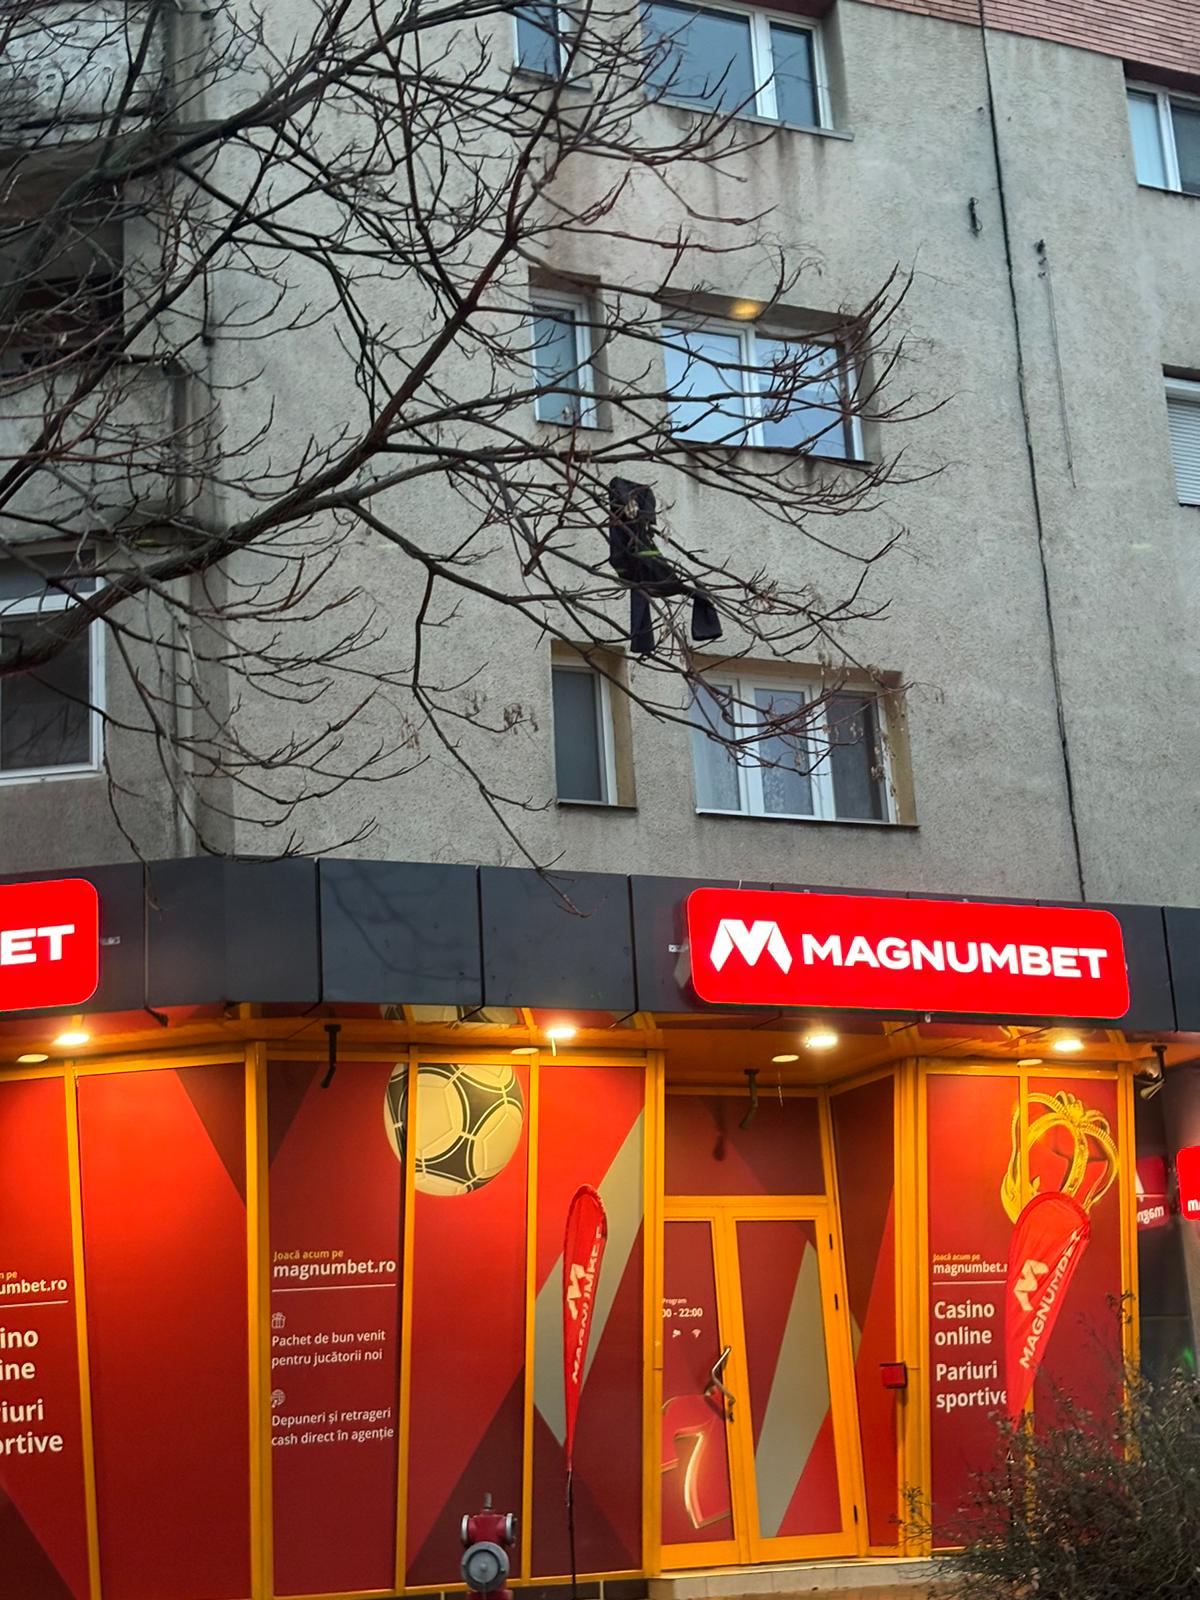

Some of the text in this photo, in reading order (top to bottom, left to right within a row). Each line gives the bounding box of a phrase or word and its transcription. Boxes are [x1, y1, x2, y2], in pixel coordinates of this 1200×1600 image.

[0, 923, 75, 966] ET
[801, 933, 1108, 979] MAGNUMBET
[302, 1250, 329, 1259] acum
[331, 1250, 344, 1259] pe
[273, 1259, 396, 1280] magnumbet.ro
[679, 1307, 703, 1317] 22:00
[934, 1300, 995, 1319] Casino
[0, 1327, 39, 1349] ino
[271, 1329, 386, 1347] Pachet de bun venit
[935, 1326, 992, 1345] online
[271, 1348, 383, 1369] pentru jucătorii noi
[936, 1360, 998, 1382] Pariuri
[0, 1398, 44, 1423] iuri
[271, 1412, 326, 1428] Depuneri
[340, 1407, 391, 1422] retrageri
[0, 1431, 64, 1455] rtive
[271, 1433, 298, 1446] cash
[301, 1431, 335, 1444] direct
[337, 1430, 349, 1441] în
